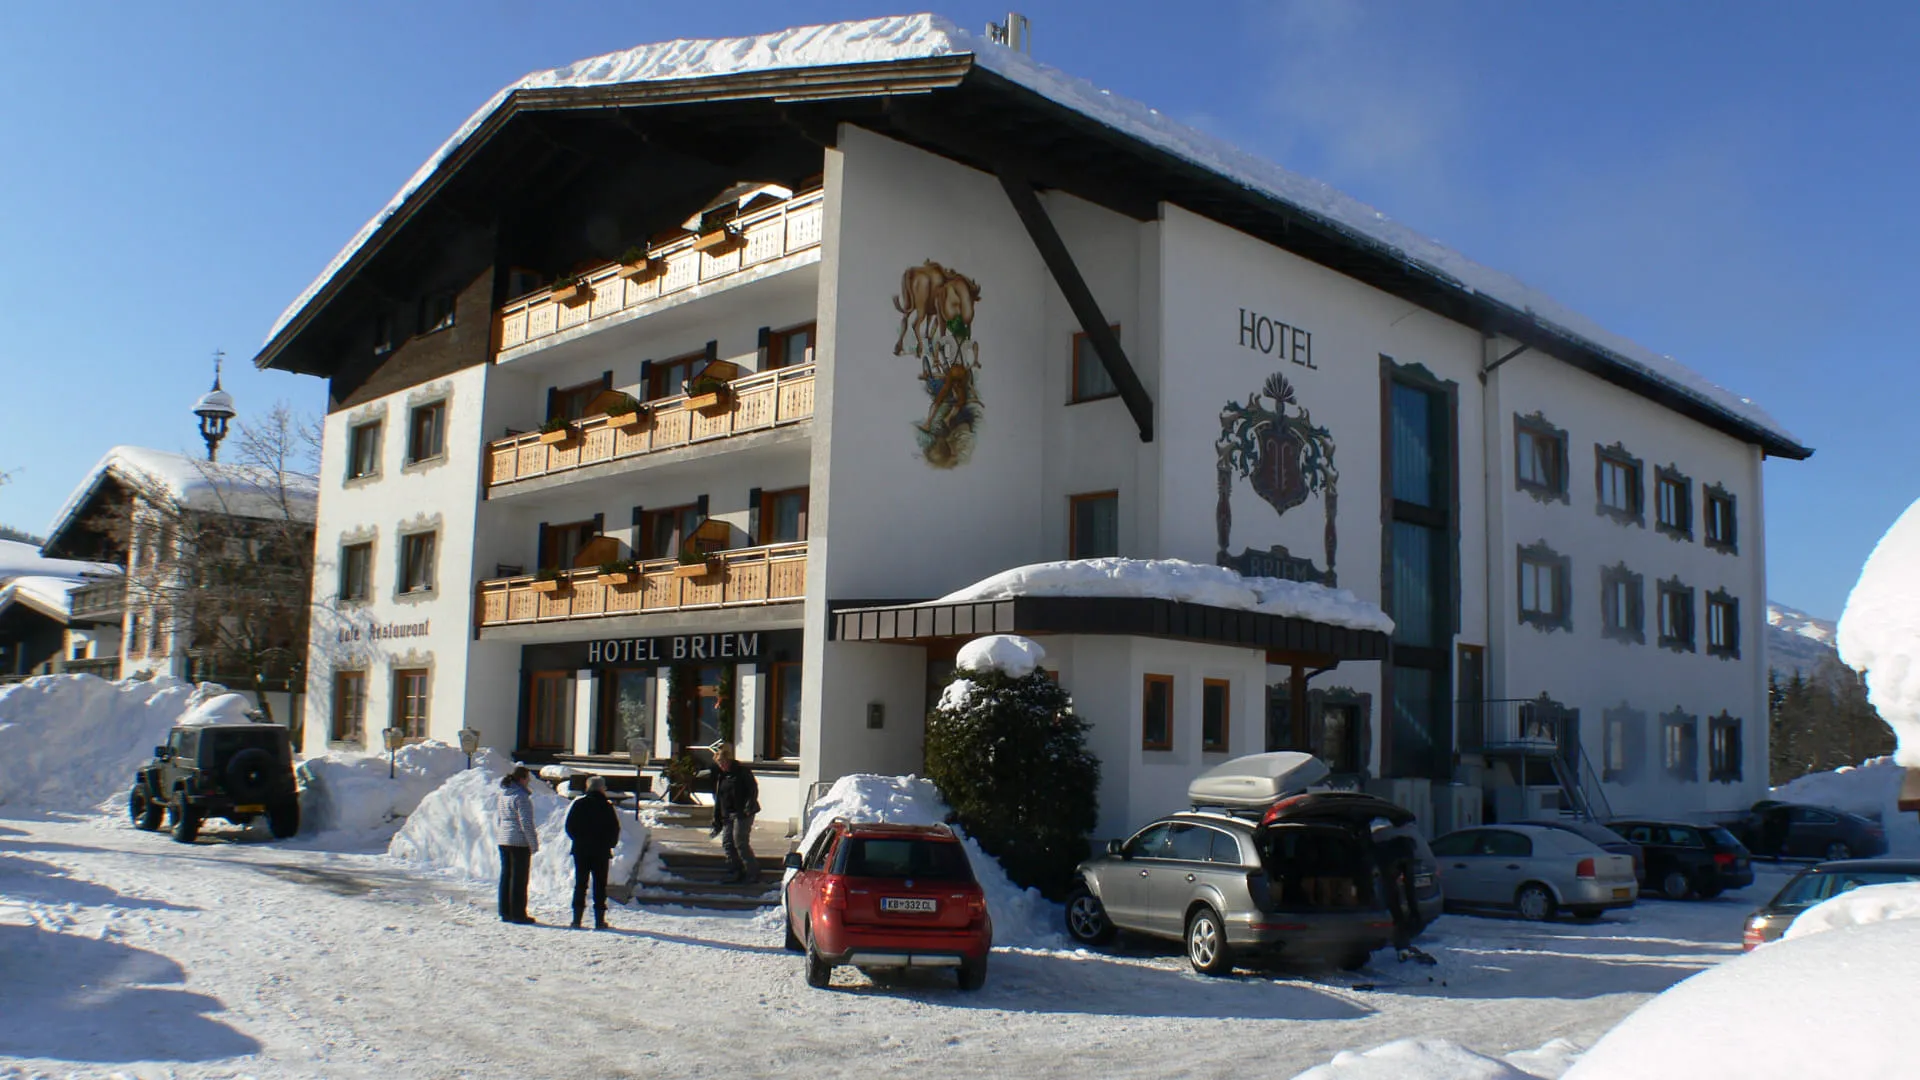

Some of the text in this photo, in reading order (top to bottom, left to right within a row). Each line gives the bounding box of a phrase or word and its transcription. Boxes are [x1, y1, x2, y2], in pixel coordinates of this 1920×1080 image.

[1238, 308, 1318, 370] HOTEL
[1250, 557, 1307, 581] BRIEM
[369, 617, 430, 641] Restaurant
[588, 632, 758, 663] HOTEL BRIEM
